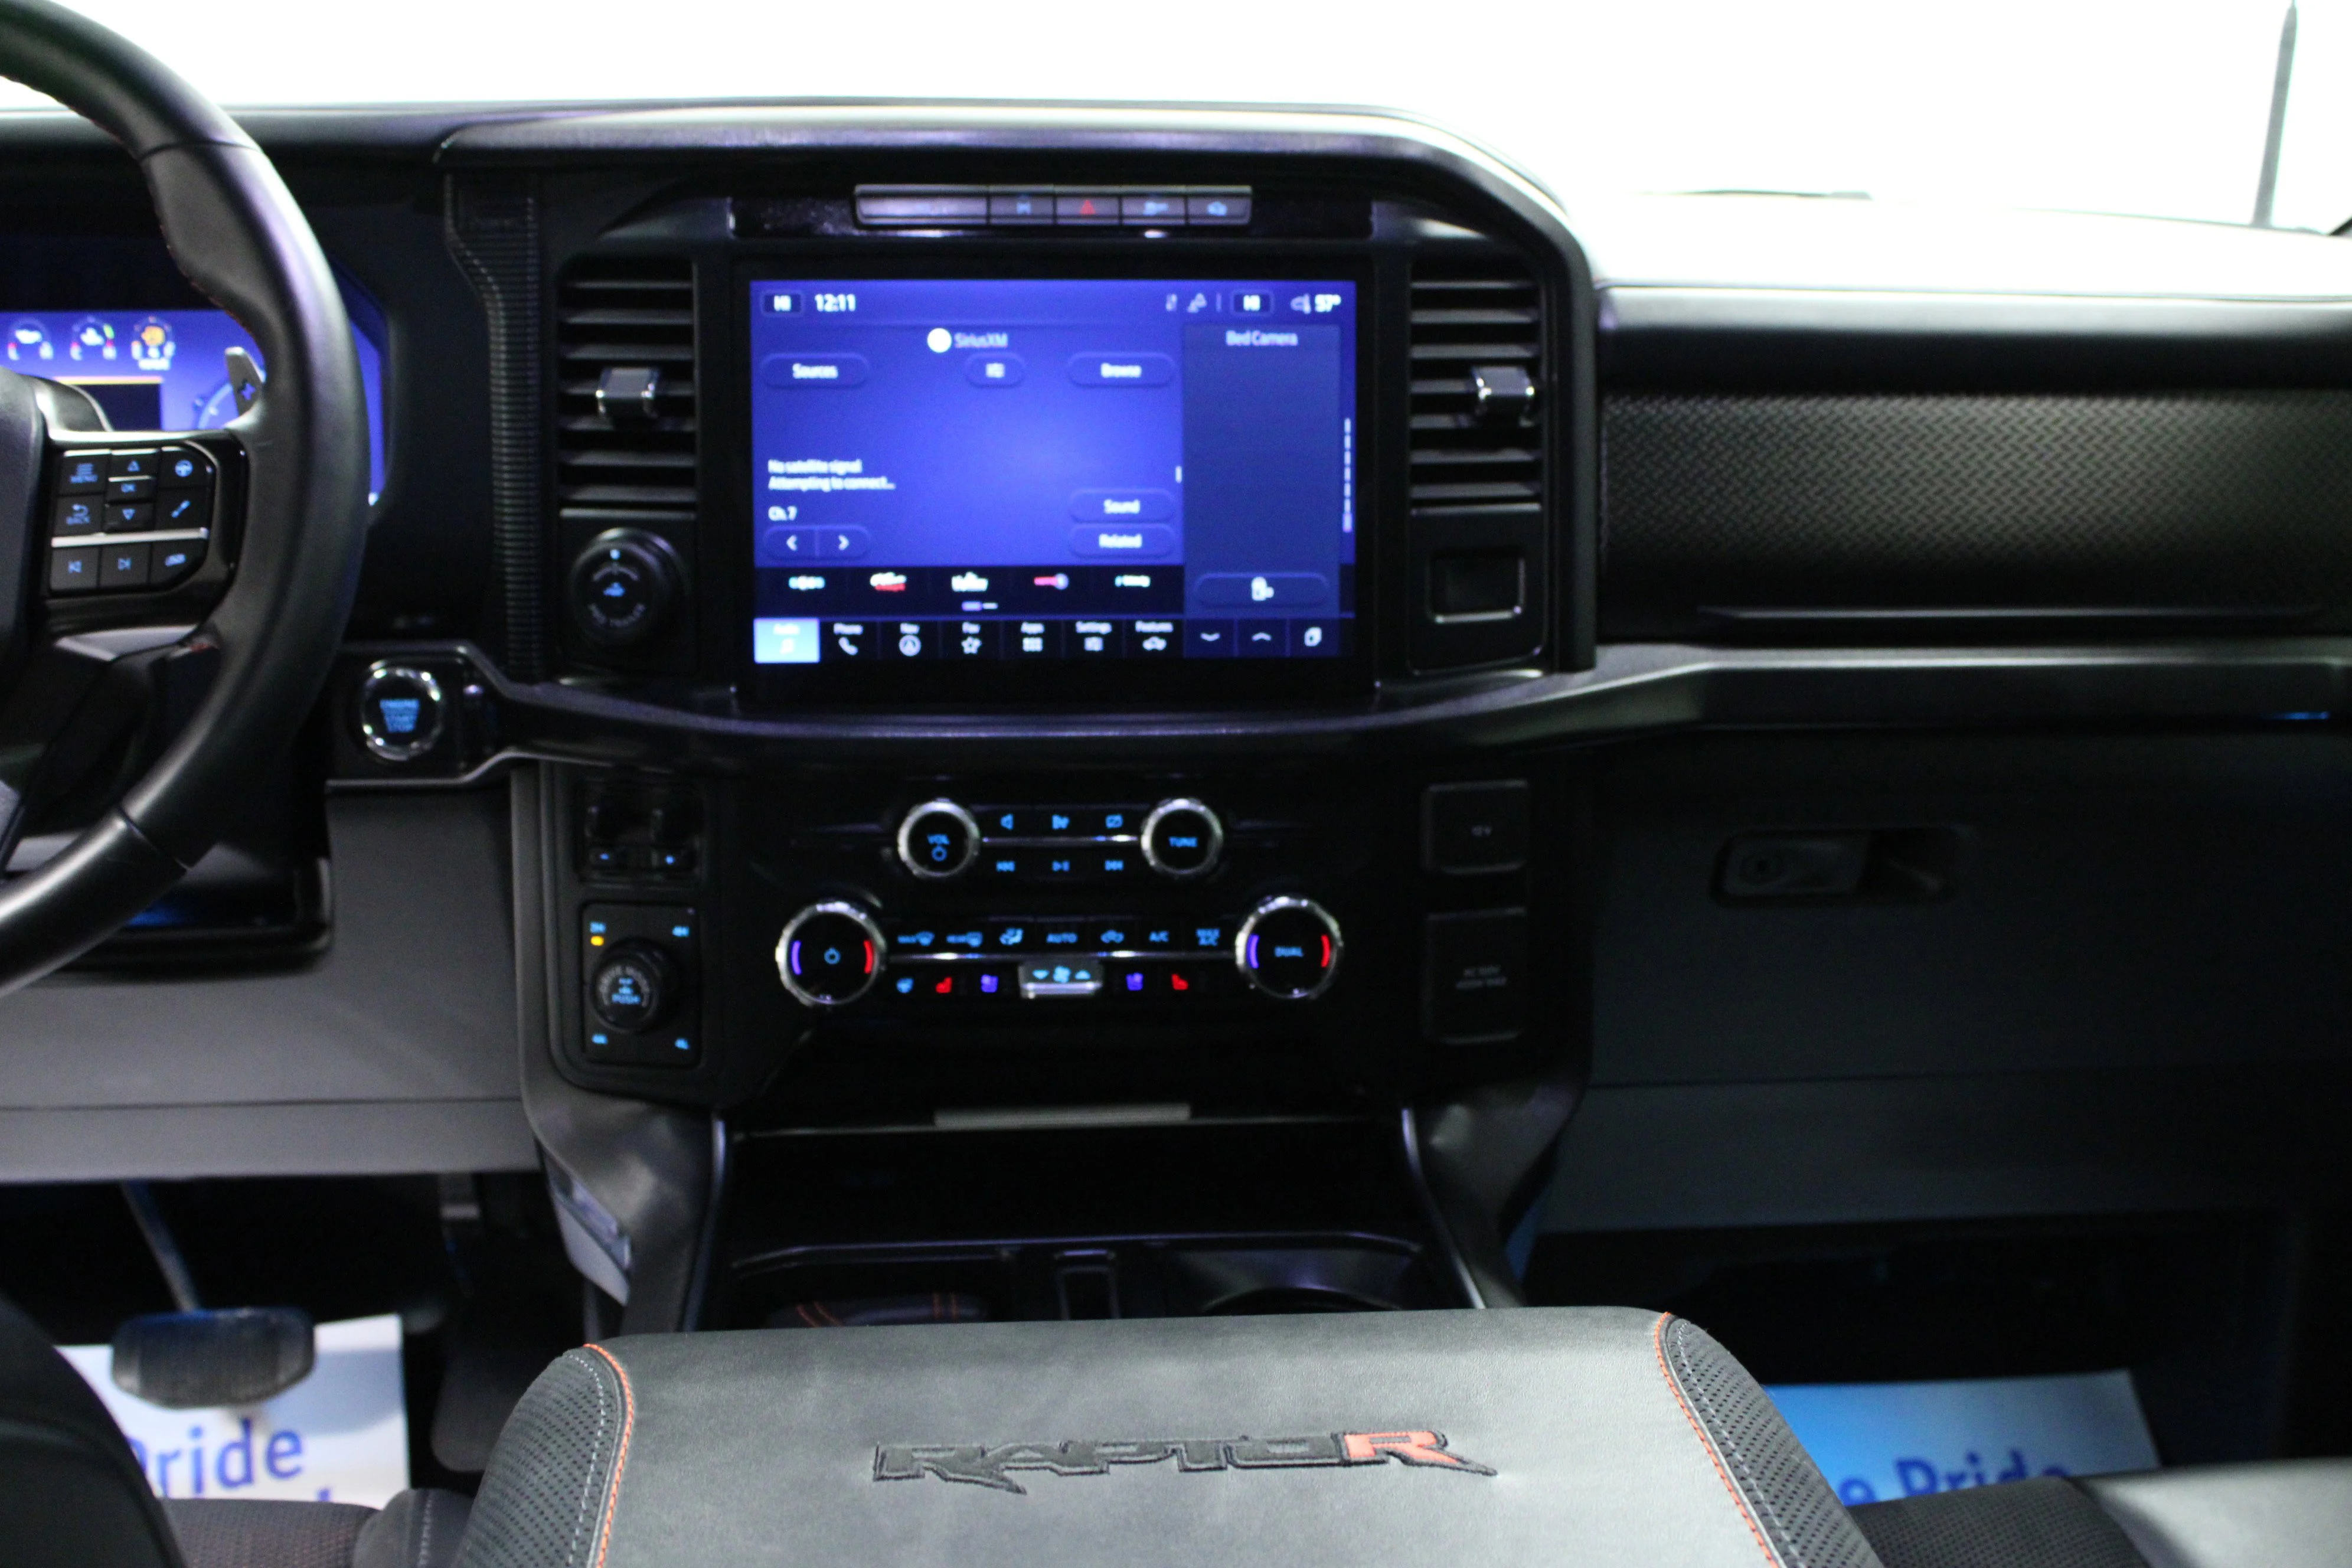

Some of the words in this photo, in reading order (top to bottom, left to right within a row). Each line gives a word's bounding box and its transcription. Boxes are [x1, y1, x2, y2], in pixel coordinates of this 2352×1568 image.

[814, 293, 855, 312] 12:11
[1252, 330, 1298, 346] Camera
[1169, 837, 1197, 847] TUNE
[1046, 932, 1078, 943] AUTO
[1149, 931, 1169, 942] A/C
[1275, 946, 1304, 958] DUAL
